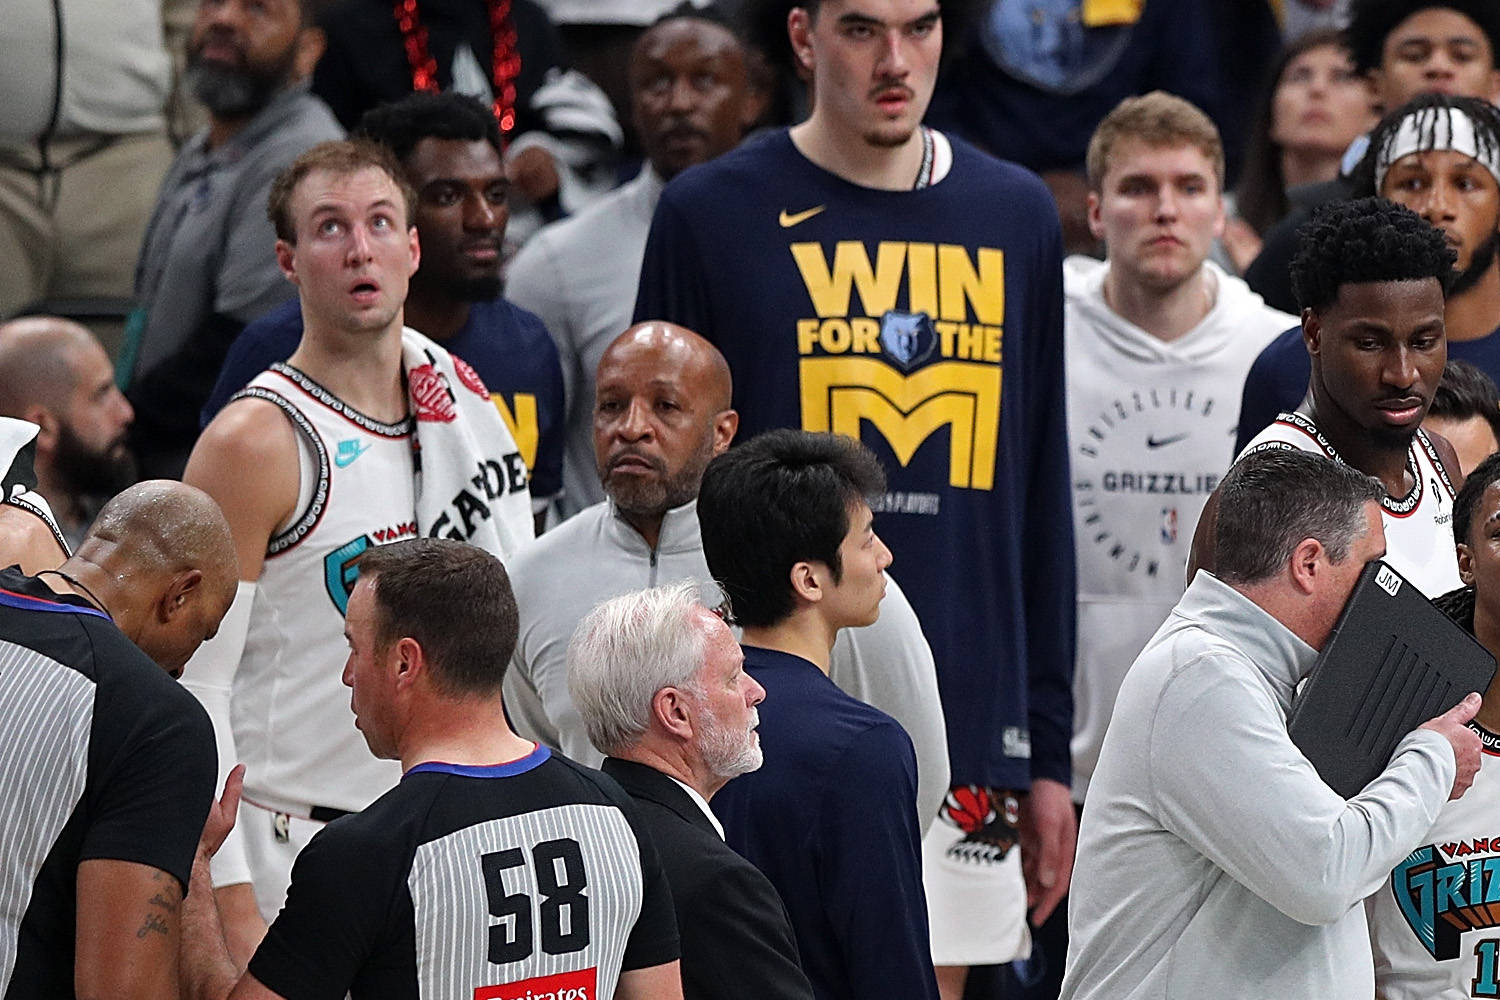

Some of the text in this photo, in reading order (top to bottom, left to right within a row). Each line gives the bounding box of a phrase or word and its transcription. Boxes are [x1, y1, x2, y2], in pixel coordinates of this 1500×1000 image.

[790, 240, 1004, 326] WIN
[797, 318, 1003, 363] FOR THE
[1379, 572, 1399, 593] JM
[481, 838, 590, 965] 58
